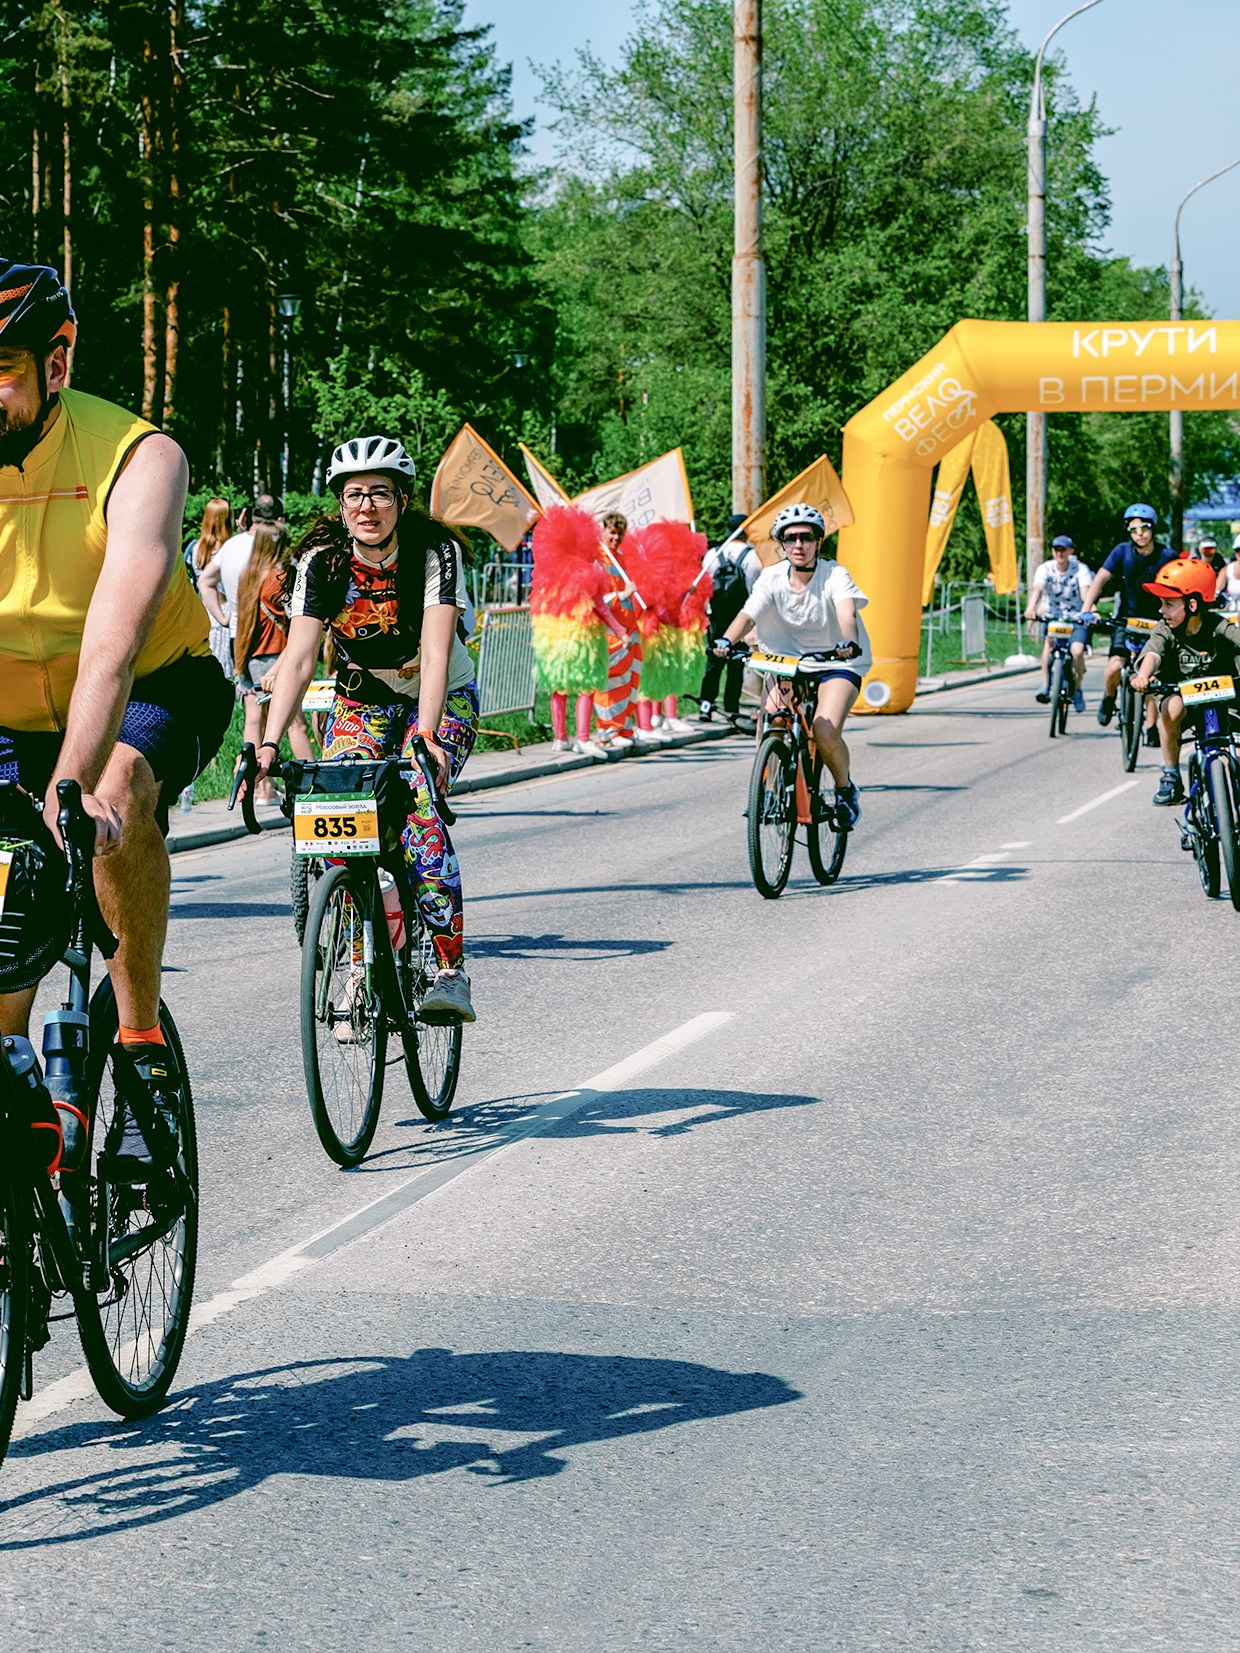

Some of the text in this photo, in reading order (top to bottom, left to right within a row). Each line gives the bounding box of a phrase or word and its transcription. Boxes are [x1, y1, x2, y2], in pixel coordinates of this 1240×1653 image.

[1072, 327, 1217, 358] КРУТИ
[882, 361, 948, 422] ПЕРМСКИЙ
[1039, 371, 1238, 404] В ПЕРМИ
[1194, 680, 1219, 692] 914
[336, 720, 360, 733] STOP
[314, 817, 357, 838] 835
